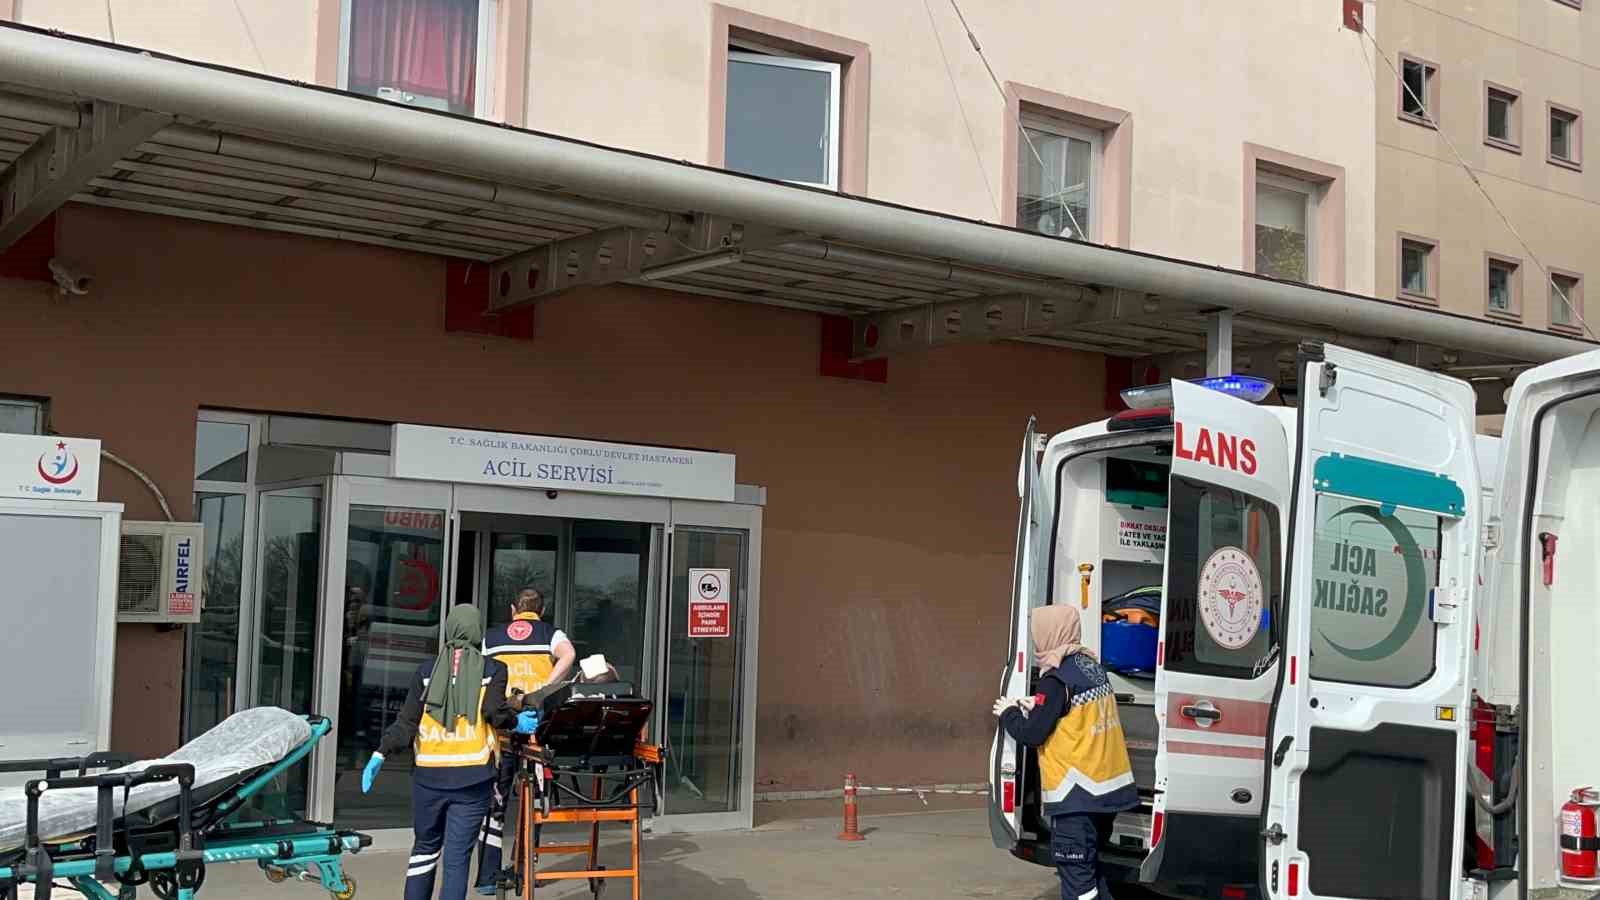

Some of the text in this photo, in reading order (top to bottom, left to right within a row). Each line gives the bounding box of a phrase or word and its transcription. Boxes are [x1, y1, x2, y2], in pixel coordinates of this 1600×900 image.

[469, 437, 508, 449] SAĞLIK
[603, 449, 641, 461] DEVLET
[642, 452, 694, 465] HASTANESİ
[1175, 421, 1257, 475] LANS
[482, 457, 615, 485] ACİL SERVİSİ
[176, 538, 190, 593] AIRFEL
